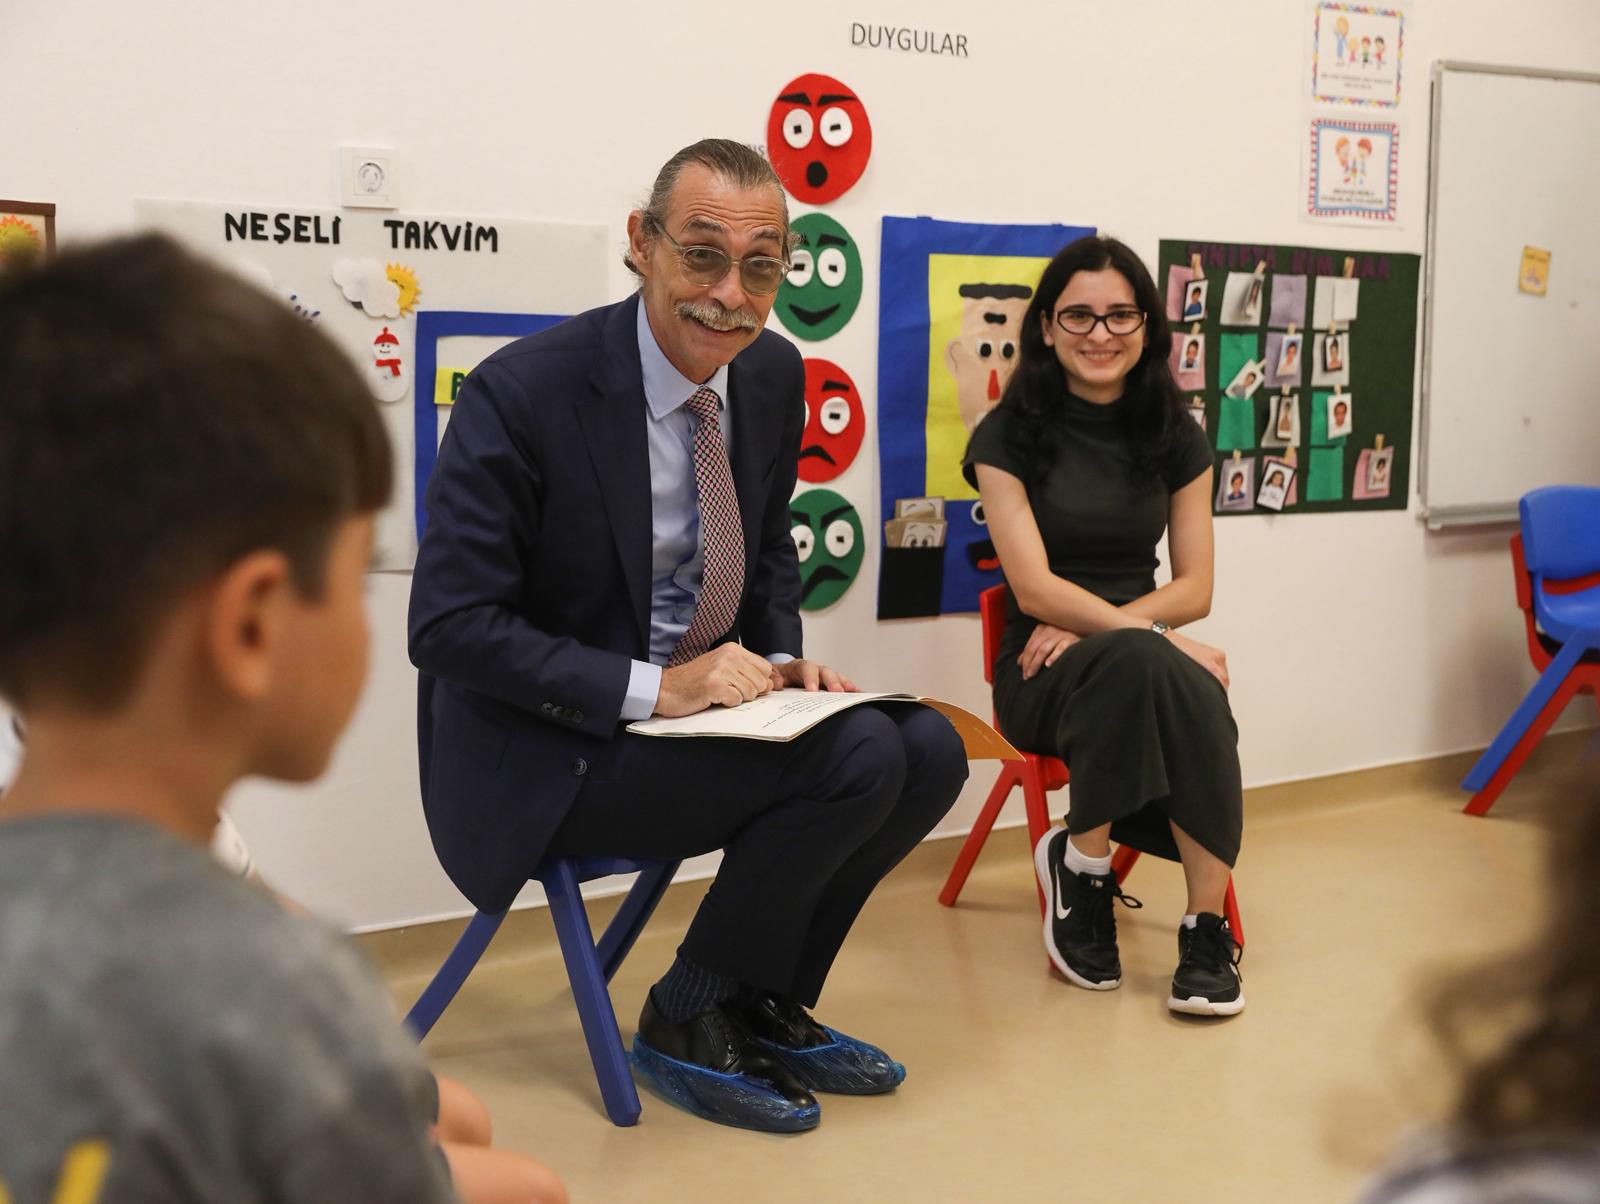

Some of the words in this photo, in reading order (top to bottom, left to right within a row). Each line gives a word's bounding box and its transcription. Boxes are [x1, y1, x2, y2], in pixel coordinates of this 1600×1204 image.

[851, 22, 968, 57] DUYGULAR
[225, 212, 341, 244] NEŞELİ
[384, 219, 498, 253] TAKVİM
